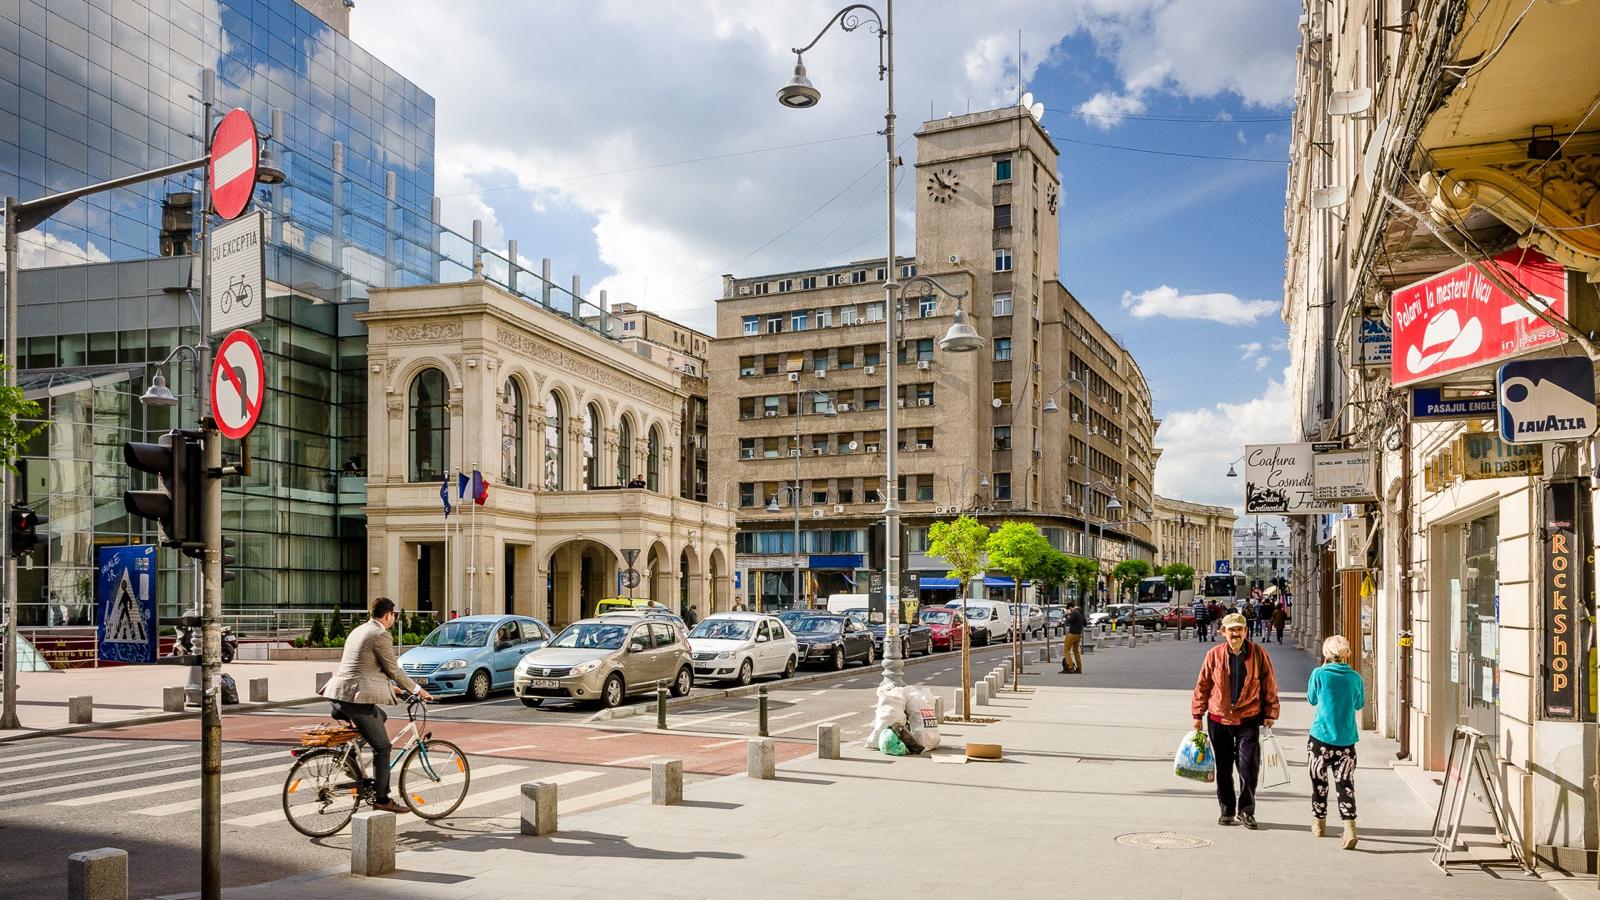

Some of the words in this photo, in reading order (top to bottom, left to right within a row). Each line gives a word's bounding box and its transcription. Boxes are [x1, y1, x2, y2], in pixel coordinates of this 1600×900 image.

[212, 245, 221, 262] CU
[222, 230, 257, 257] EXCEPTIA
[1396, 293, 1422, 332] Palarii
[1425, 285, 1435, 310] la
[1436, 271, 1472, 305] mesterul
[1471, 273, 1493, 304] Nicu
[1502, 340, 1514, 350] in
[1427, 403, 1467, 414] PASAJUL
[1517, 414, 1587, 433] LAVAZZA
[1247, 446, 1296, 473] Coafura
[1480, 460, 1492, 473] in
[1267, 469, 1314, 488] Cosmeti
